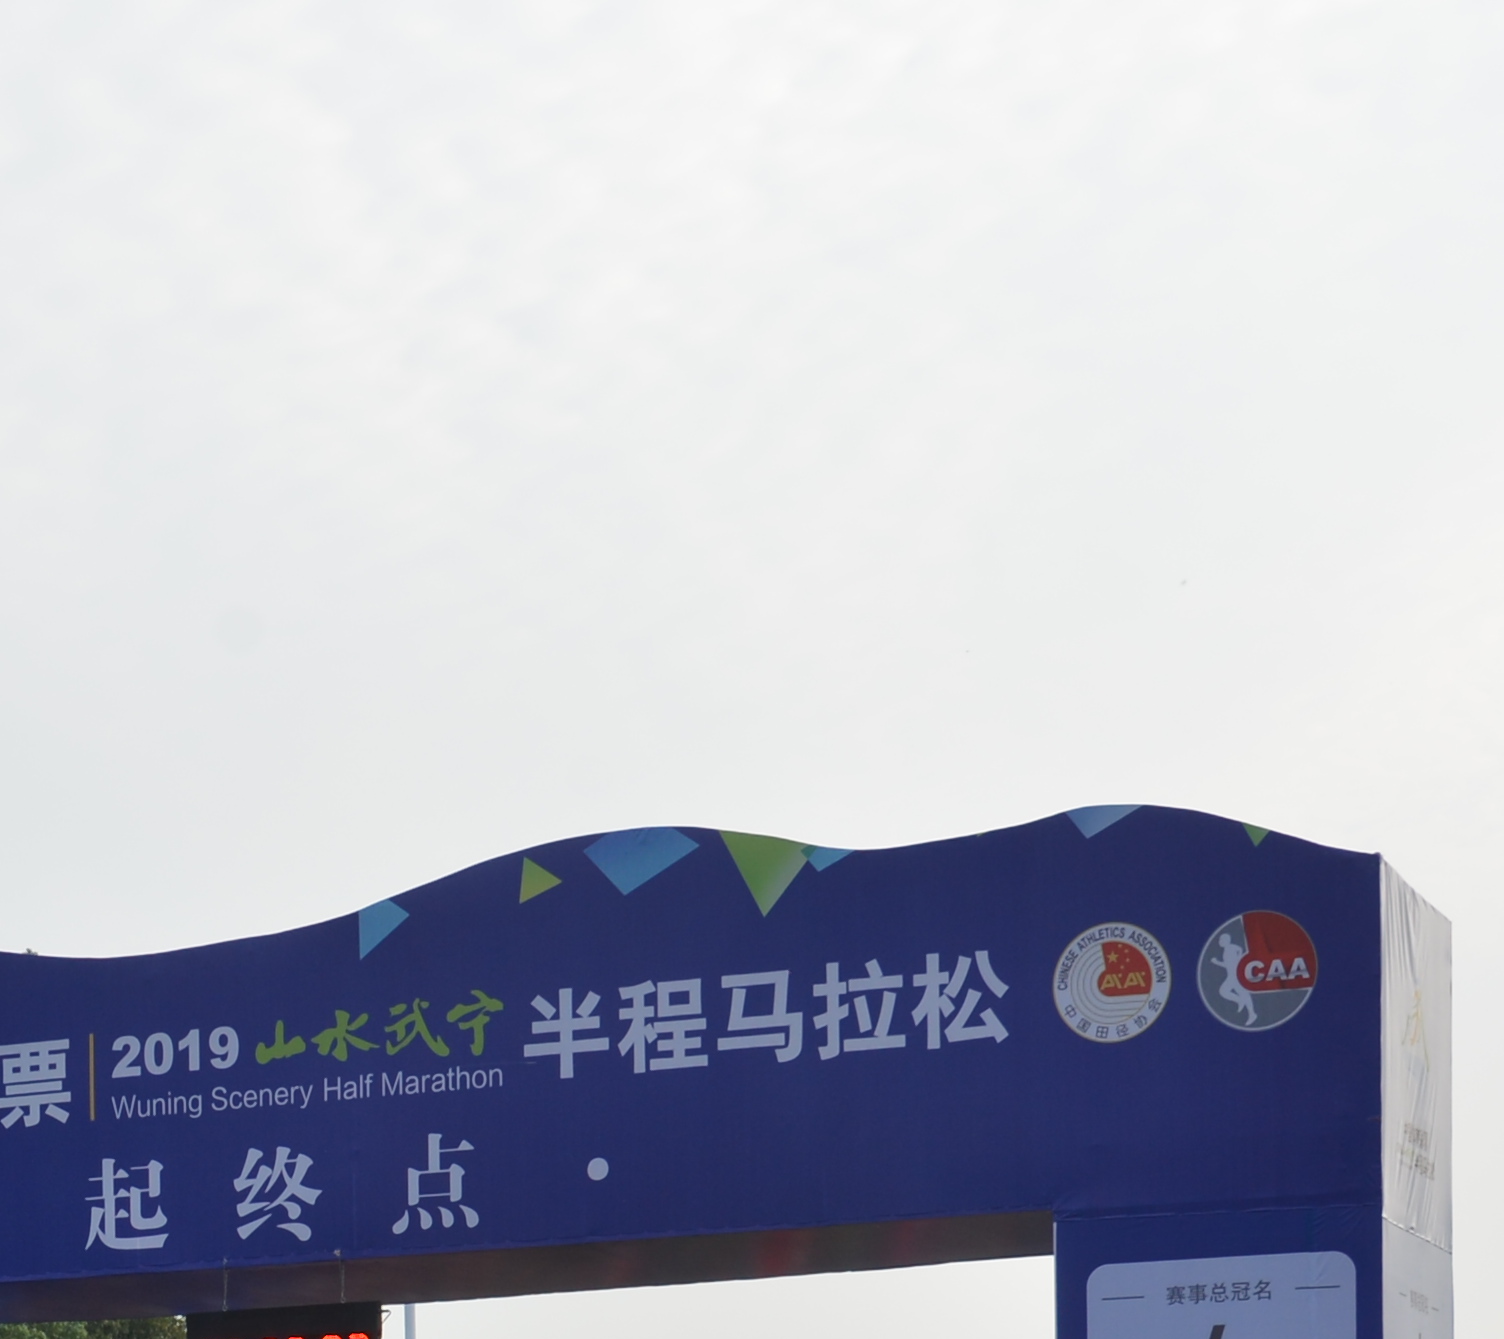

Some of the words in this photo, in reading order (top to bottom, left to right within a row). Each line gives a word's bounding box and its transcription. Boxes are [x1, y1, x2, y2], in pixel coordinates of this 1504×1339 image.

[1244, 957, 1310, 983] CAA
[254, 989, 504, 1065] 山水武宁
[523, 949, 1010, 1080] 半程马拉松
[111, 1026, 240, 1079] 2019
[111, 1091, 203, 1120] Wuning
[211, 1082, 313, 1112] Scenery
[323, 1072, 374, 1102] Half
[381, 1065, 504, 1097] Marathon
[84, 1132, 480, 1251] 起终点
[1166, 1279, 1272, 1306] 赛事总冠名
